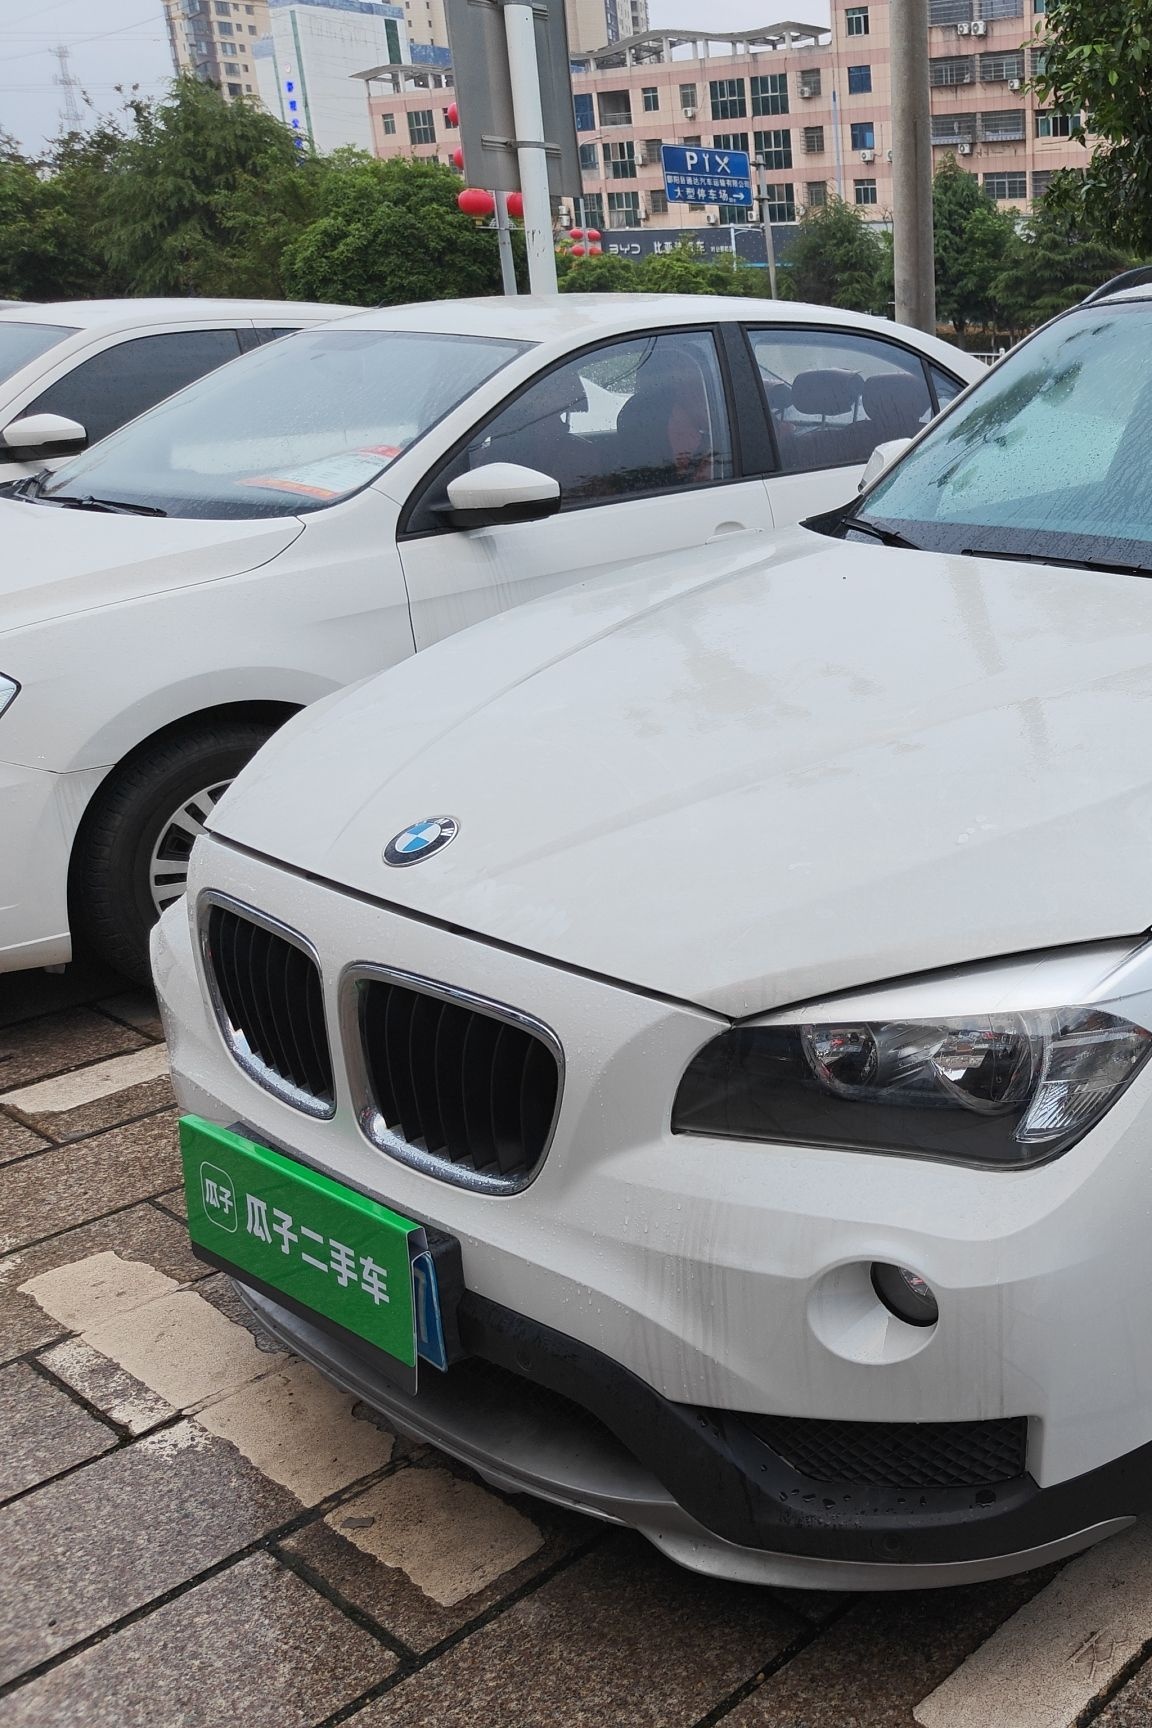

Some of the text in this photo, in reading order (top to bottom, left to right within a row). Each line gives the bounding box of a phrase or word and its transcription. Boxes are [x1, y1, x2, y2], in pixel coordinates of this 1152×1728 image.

[686, 151, 699, 171] P
[674, 186, 729, 202] 大型停车场
[609, 244, 641, 255] BYD
[205, 1178, 234, 1215] 瓜子
[245, 1192, 391, 1306] 瓜子二手车
